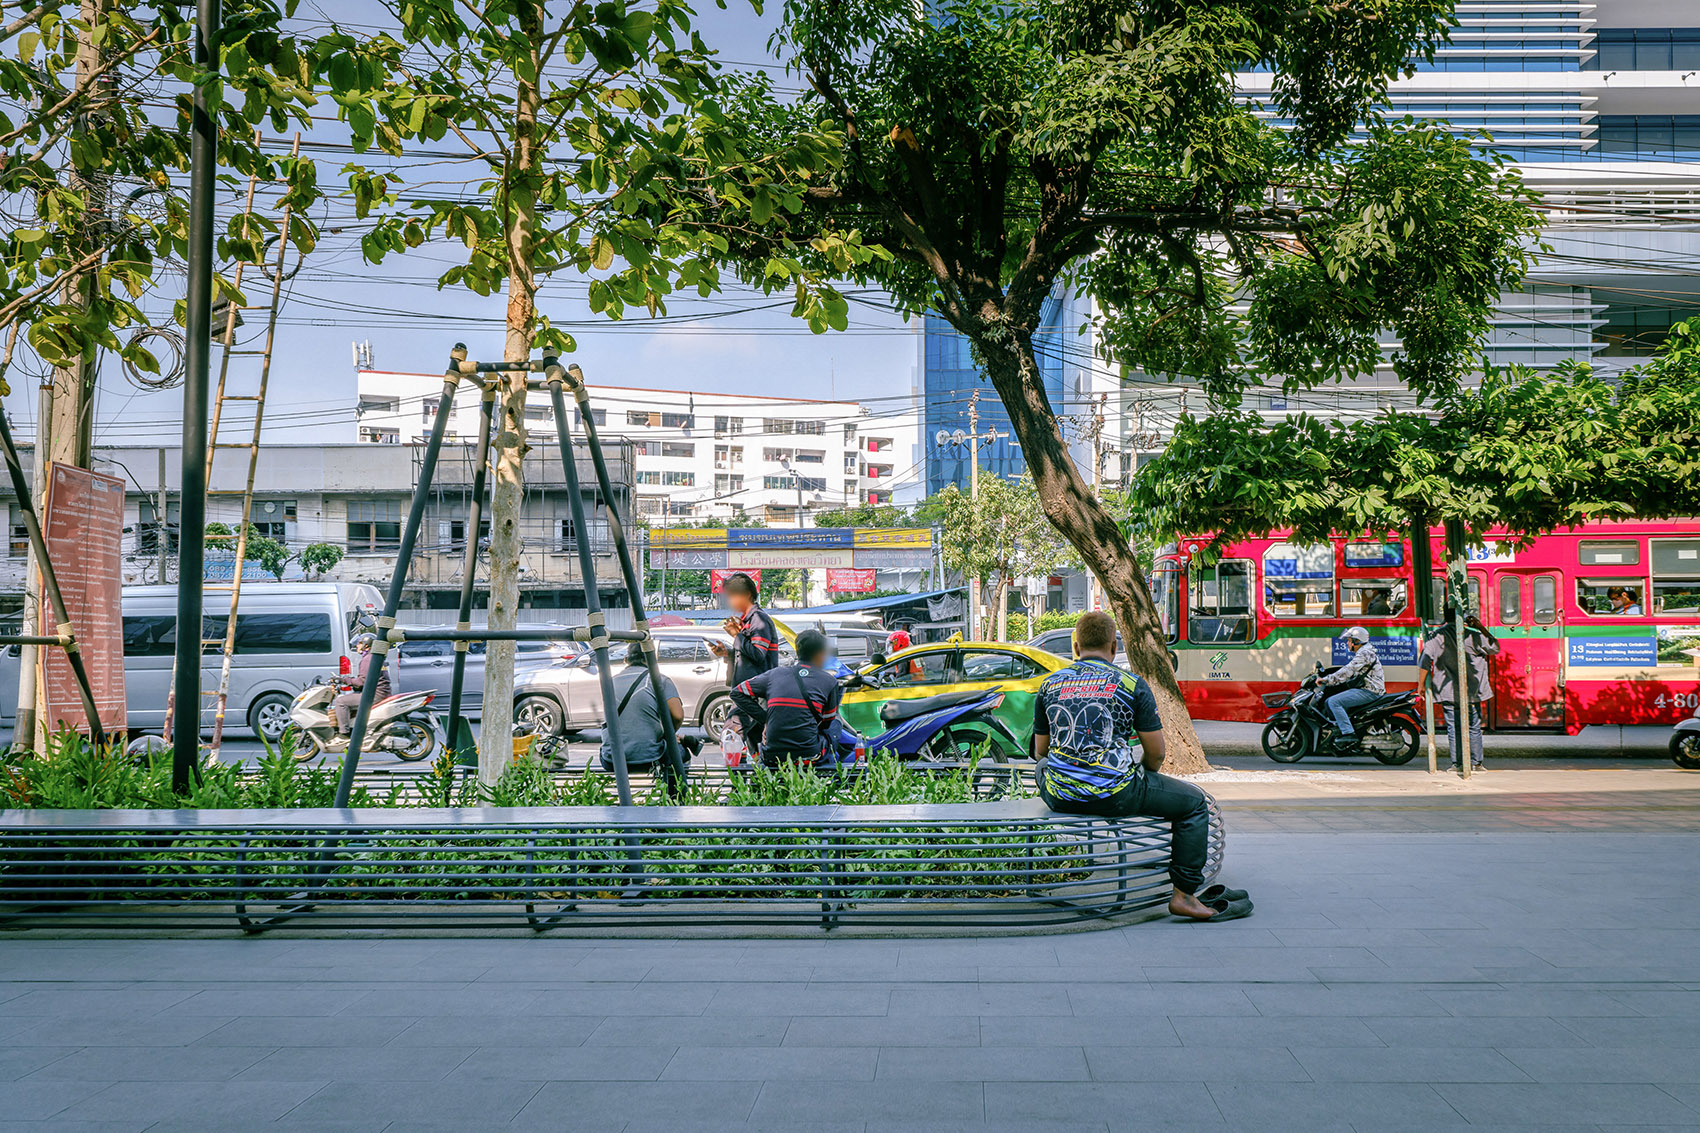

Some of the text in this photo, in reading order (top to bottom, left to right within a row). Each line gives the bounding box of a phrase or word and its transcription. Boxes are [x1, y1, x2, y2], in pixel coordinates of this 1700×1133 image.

[1334, 642, 1347, 651] 13
[1571, 645, 1584, 653] 13
[1103, 683, 1118, 693] 2
